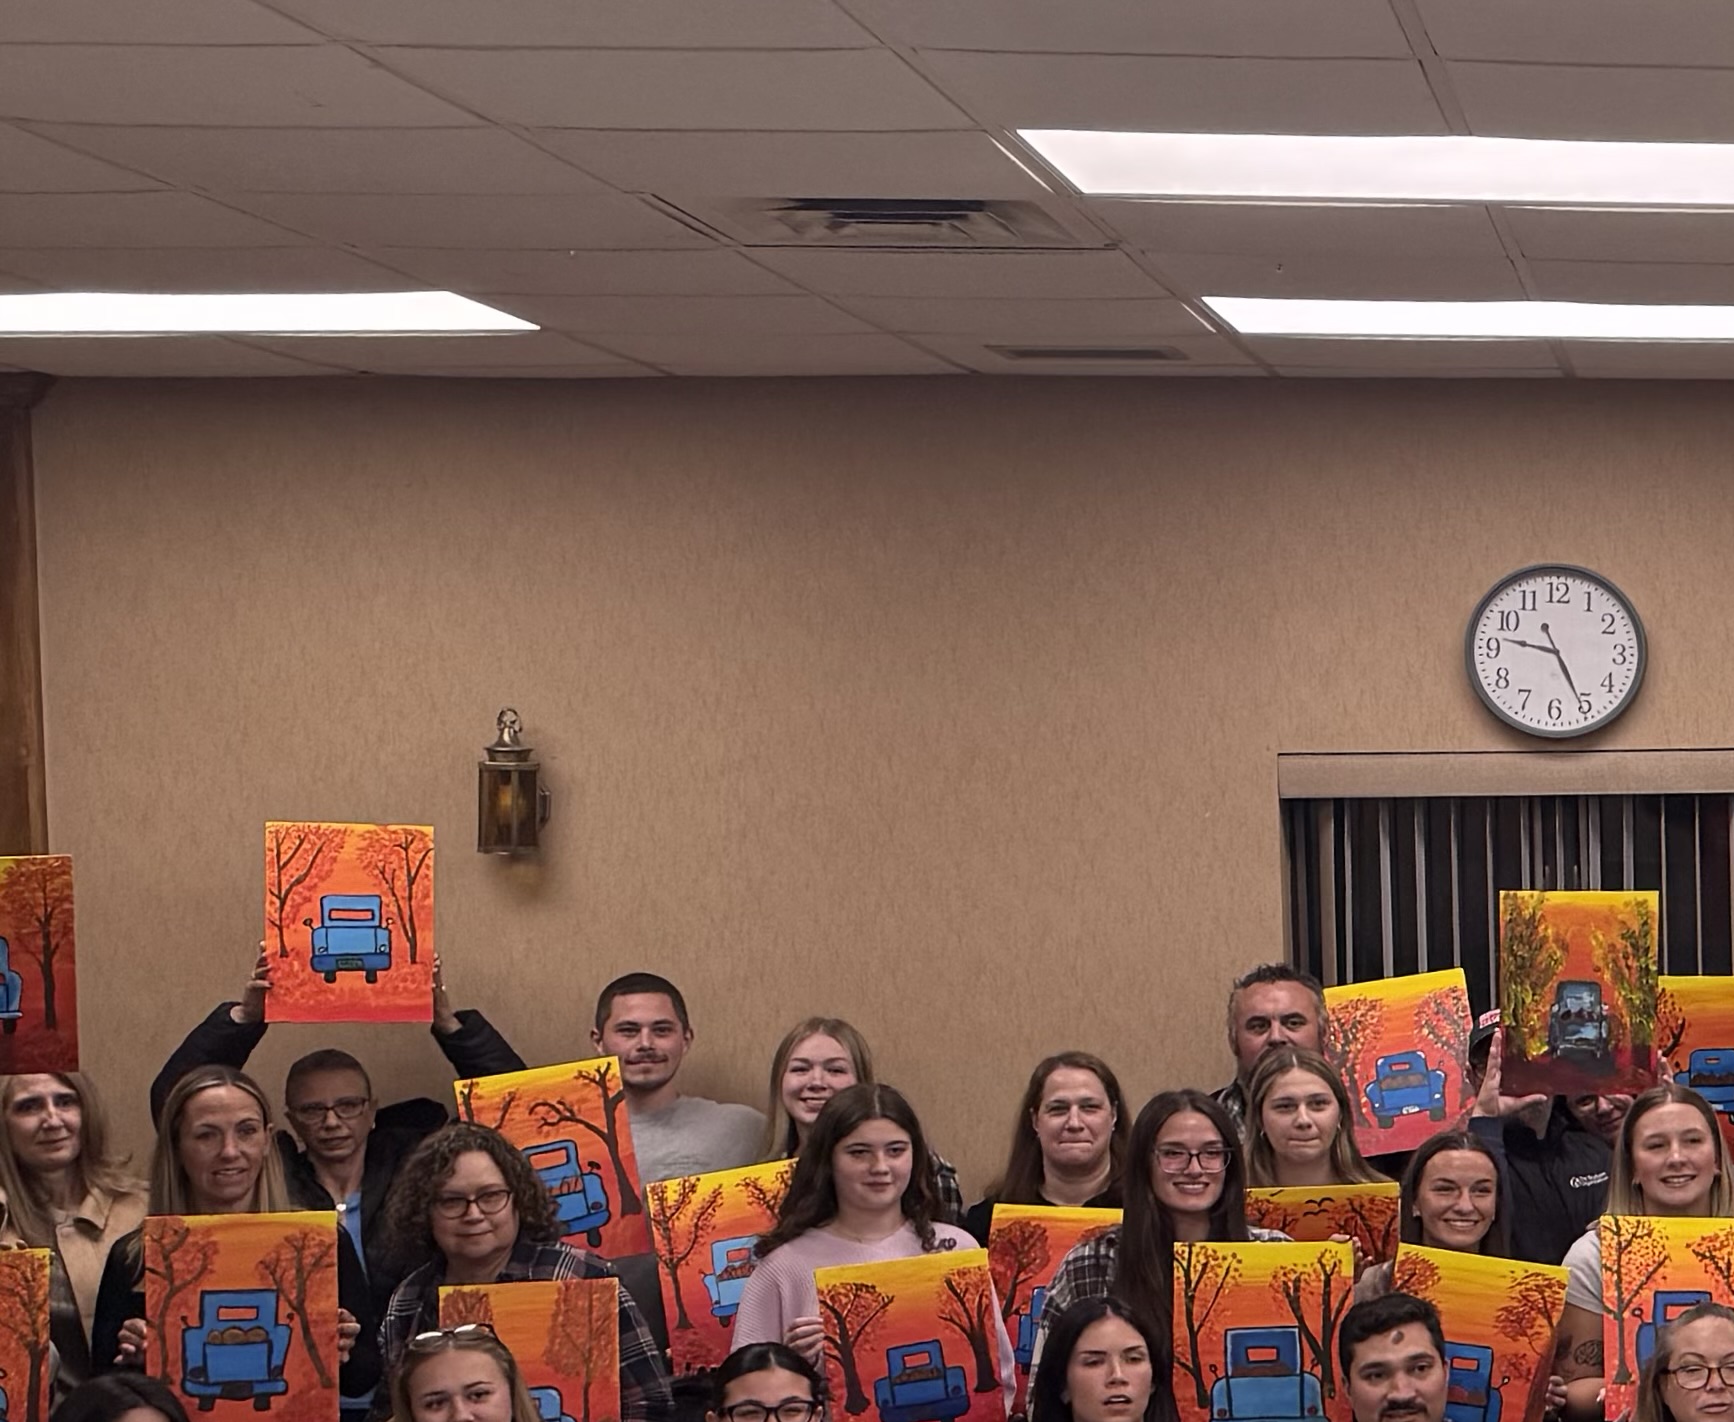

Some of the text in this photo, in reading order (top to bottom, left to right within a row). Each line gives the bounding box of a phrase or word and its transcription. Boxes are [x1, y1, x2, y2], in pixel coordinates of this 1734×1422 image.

[1518, 589, 1538, 612] 11
[1545, 582, 1571, 604] 12
[1583, 591, 1594, 612] 1
[1497, 610, 1520, 632] 10
[1600, 613, 1616, 635] 2
[1486, 636, 1501, 659] 9
[1612, 643, 1627, 666] 3
[1495, 666, 1510, 689] 8
[1600, 671, 1615, 694] 4
[1517, 689, 1532, 712] 7
[1547, 698, 1562, 721] 6
[1578, 692, 1592, 715] 5
